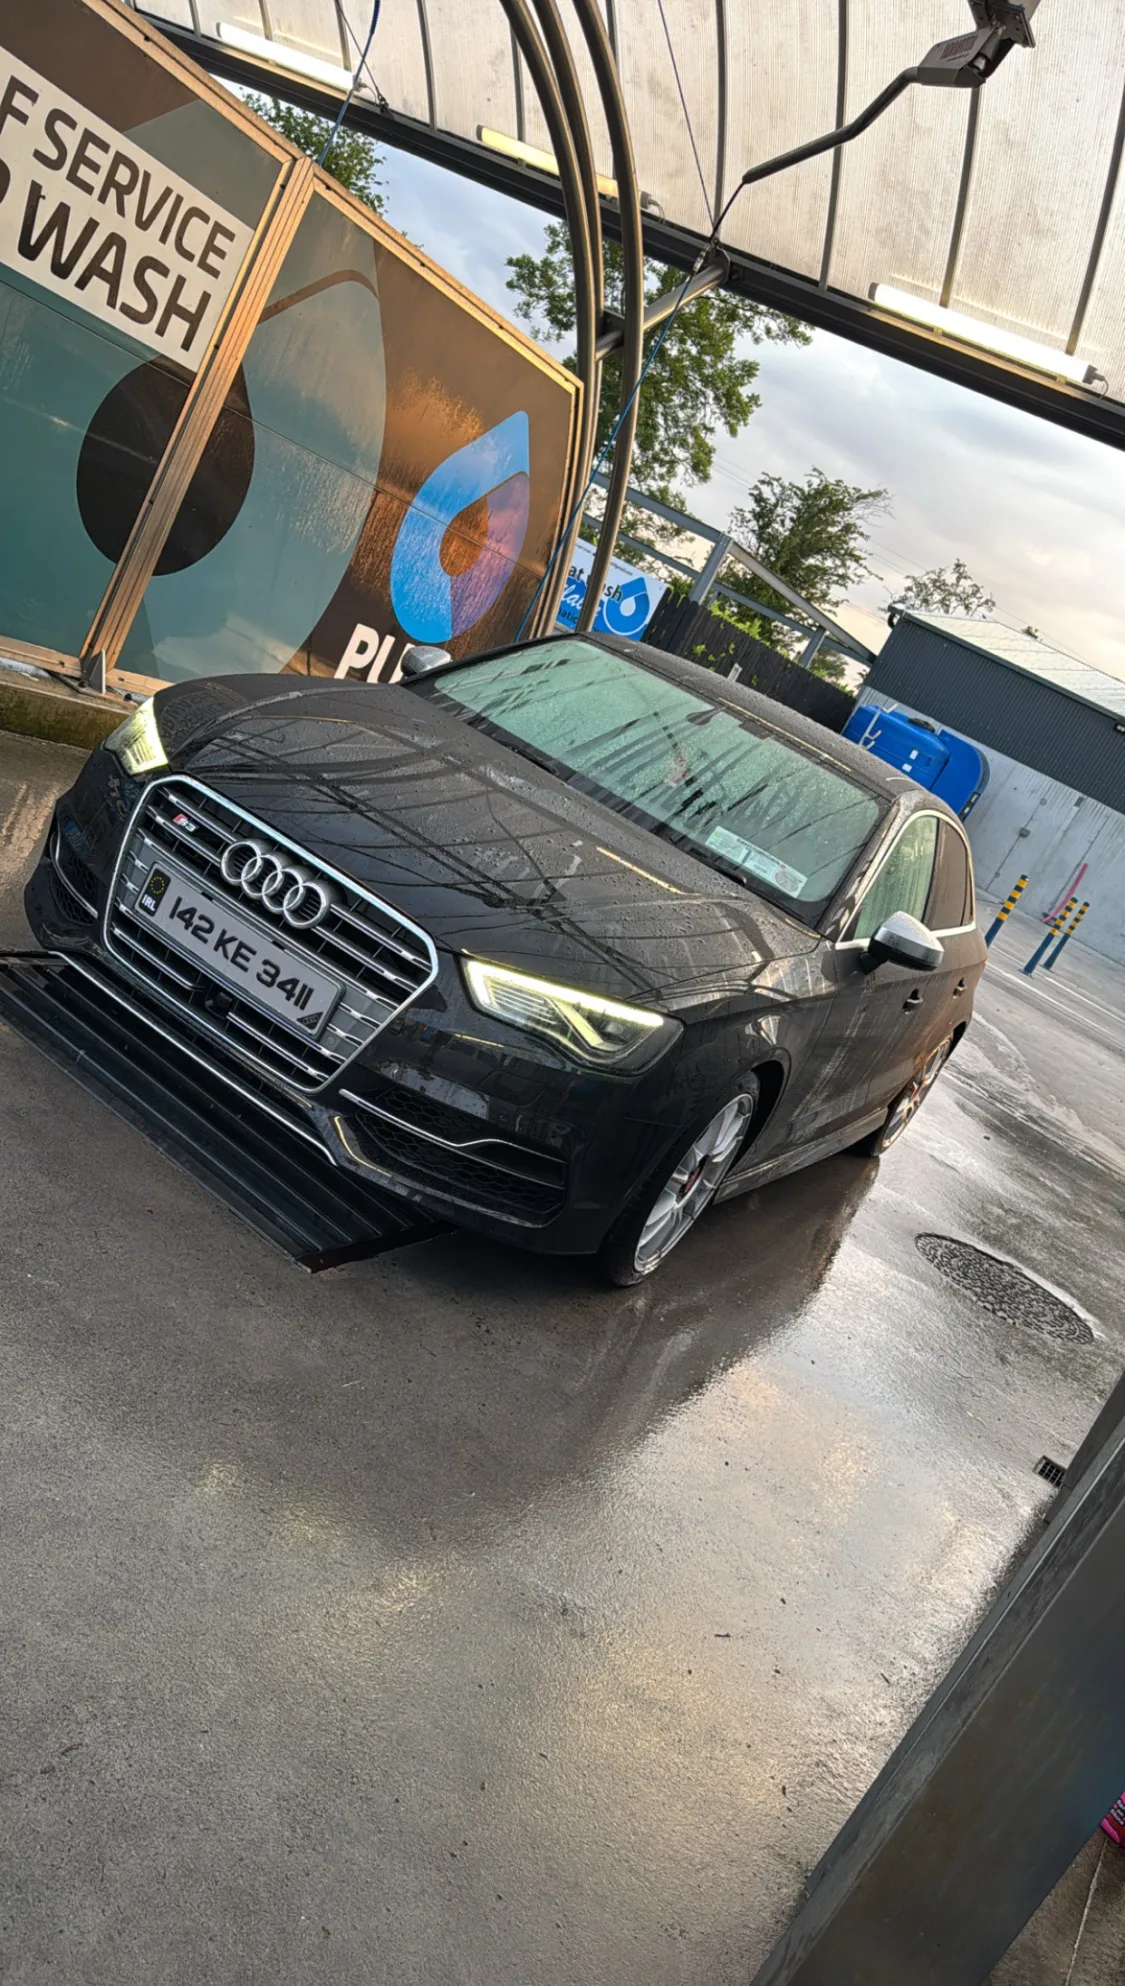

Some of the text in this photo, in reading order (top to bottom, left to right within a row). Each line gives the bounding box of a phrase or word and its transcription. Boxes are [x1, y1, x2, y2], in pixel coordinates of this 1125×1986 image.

[32, 108, 236, 280] SERVICE
[17, 179, 212, 353] WASH
[175, 815, 196, 832] S3
[141, 893, 156, 912] IRL
[169, 896, 315, 1011] 142 KE 3411
